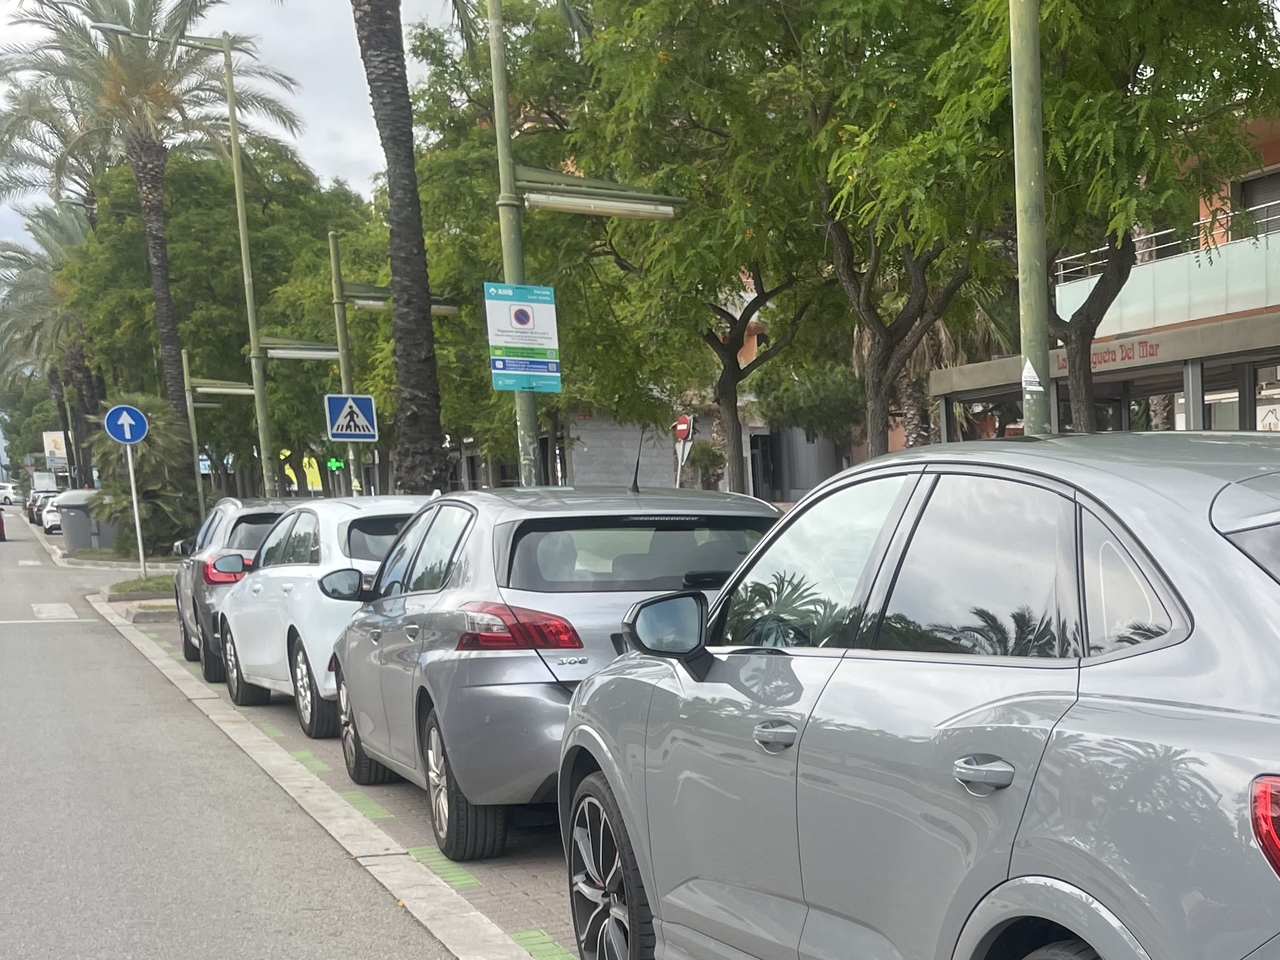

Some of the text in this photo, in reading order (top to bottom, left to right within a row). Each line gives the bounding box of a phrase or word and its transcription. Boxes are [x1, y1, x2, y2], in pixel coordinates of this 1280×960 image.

[1056, 341, 1160, 371] La gueta Del Mar
[556, 656, 589, 666] 308
